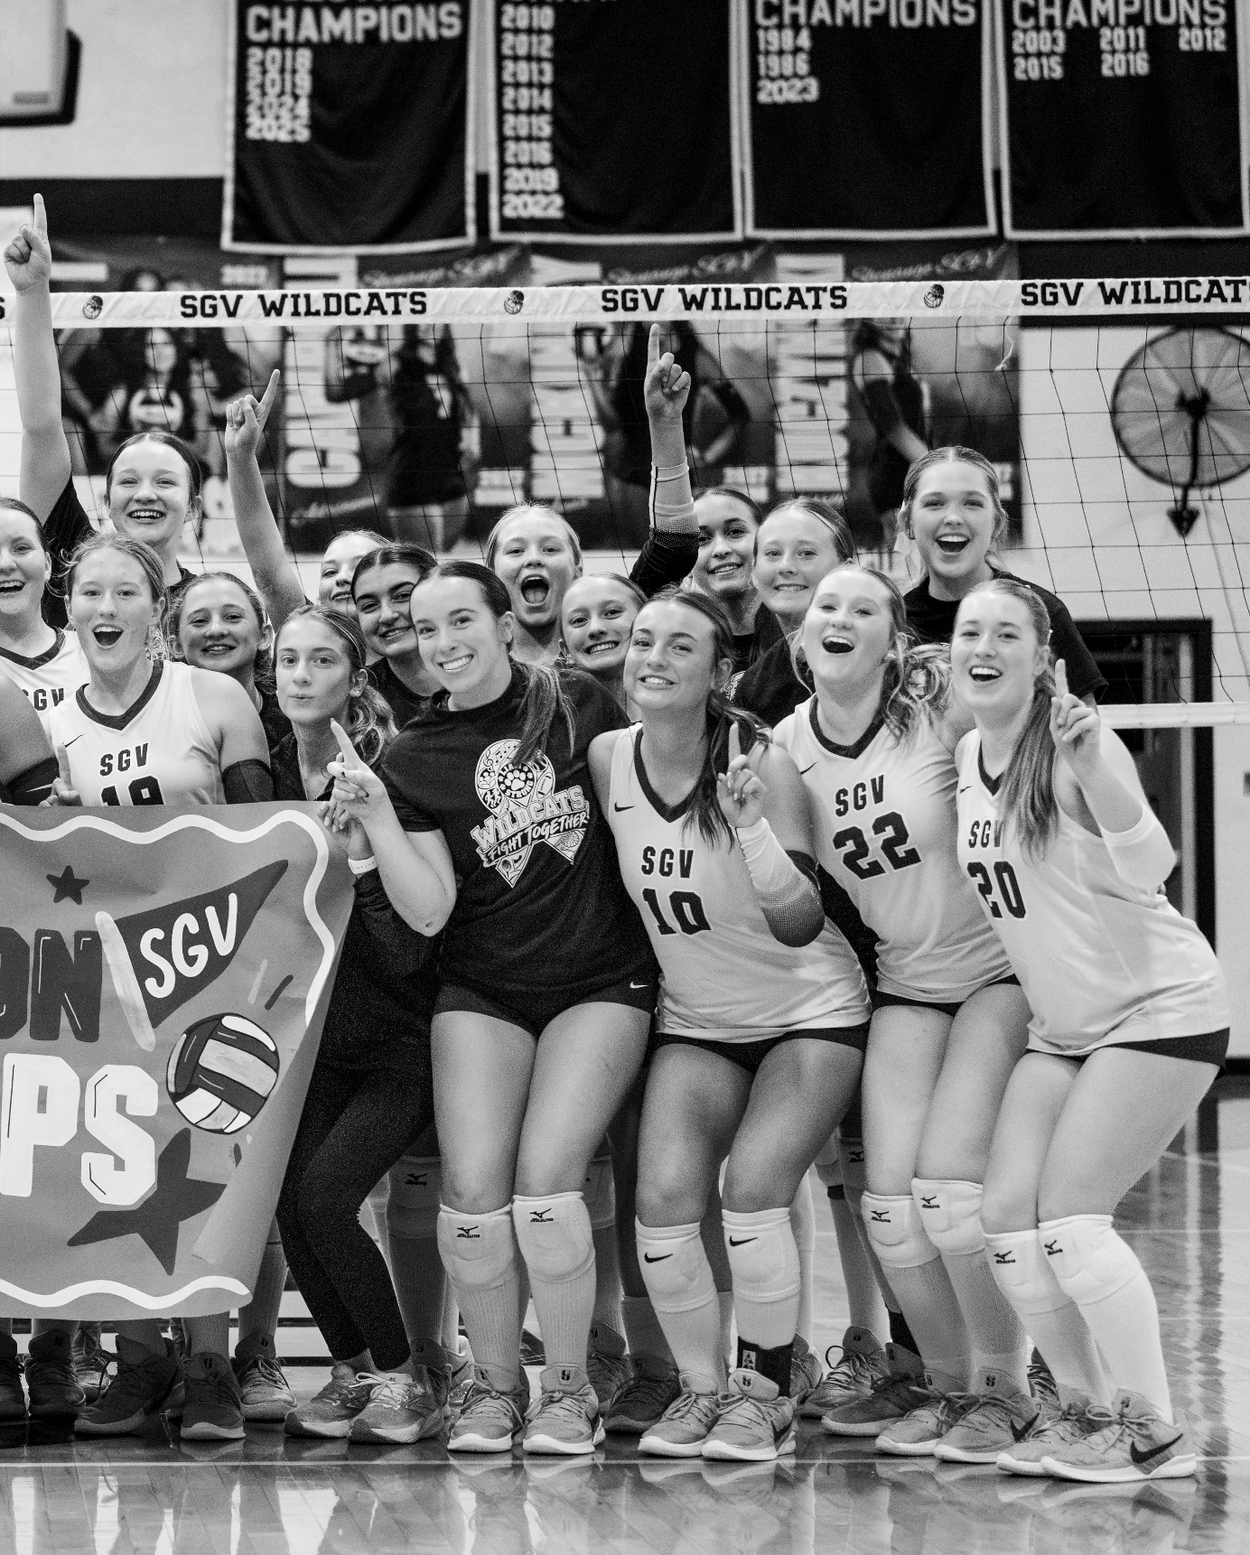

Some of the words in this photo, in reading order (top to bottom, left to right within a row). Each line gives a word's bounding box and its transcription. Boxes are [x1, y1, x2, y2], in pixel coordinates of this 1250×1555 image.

[246, 2, 464, 43] CHAMPIONS
[755, 0, 977, 27] CHAMPIONS
[1012, 0, 1228, 28] CHAMPIONS
[1011, 29, 1067, 55] 2003
[1099, 26, 1147, 52] 2011
[1177, 26, 1228, 52] 2012
[1013, 56, 1065, 81] 2015
[1101, 52, 1151, 78] 2016
[756, 77, 819, 104] 2023
[180, 293, 244, 318] SGV
[258, 291, 428, 317] WILDCATS
[602, 288, 665, 312] SGV
[678, 285, 848, 311] WILDCATS
[1021, 282, 1084, 306] SGV
[1099, 279, 1250, 305] WILDCAT
[22, 688, 65, 711] GV
[99, 742, 149, 777] SGV
[504, 780, 535, 799] STRONG
[835, 774, 885, 817] SGV
[470, 784, 589, 851] WILDCATS
[486, 828, 524, 862] FIGHT
[523, 810, 588, 848] TOGETHER
[833, 811, 922, 880] 22
[968, 820, 1004, 848] SGV
[641, 845, 694, 879] SGV
[967, 861, 1026, 919] 20
[642, 887, 712, 936] 10
[140, 892, 238, 999] SGV
